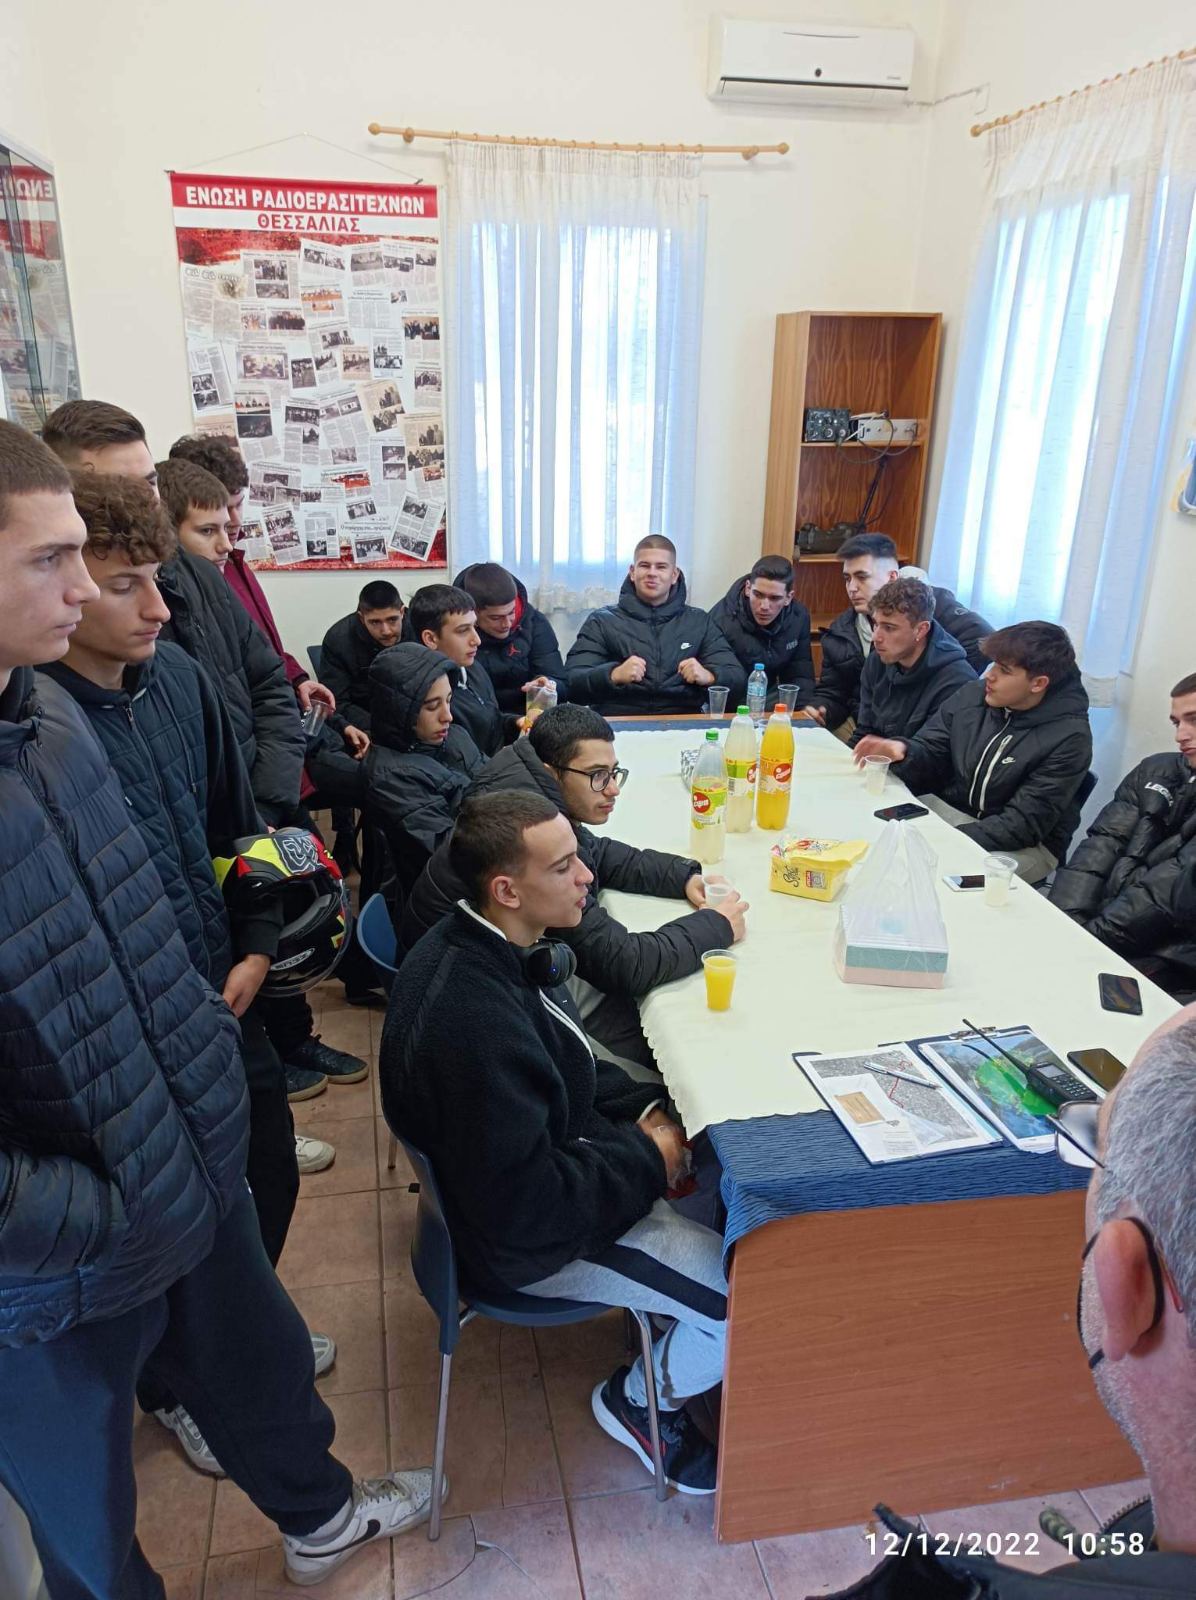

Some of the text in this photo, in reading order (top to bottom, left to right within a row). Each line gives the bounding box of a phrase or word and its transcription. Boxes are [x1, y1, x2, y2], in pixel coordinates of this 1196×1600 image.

[186, 186, 425, 214] ΕΝΩΣΗ ΡΑΔΙΟΕΡΑΣΙΤΕΧΝΩΝ
[257, 213, 361, 232] ΘΕΣΣΑΛΙΑΣ
